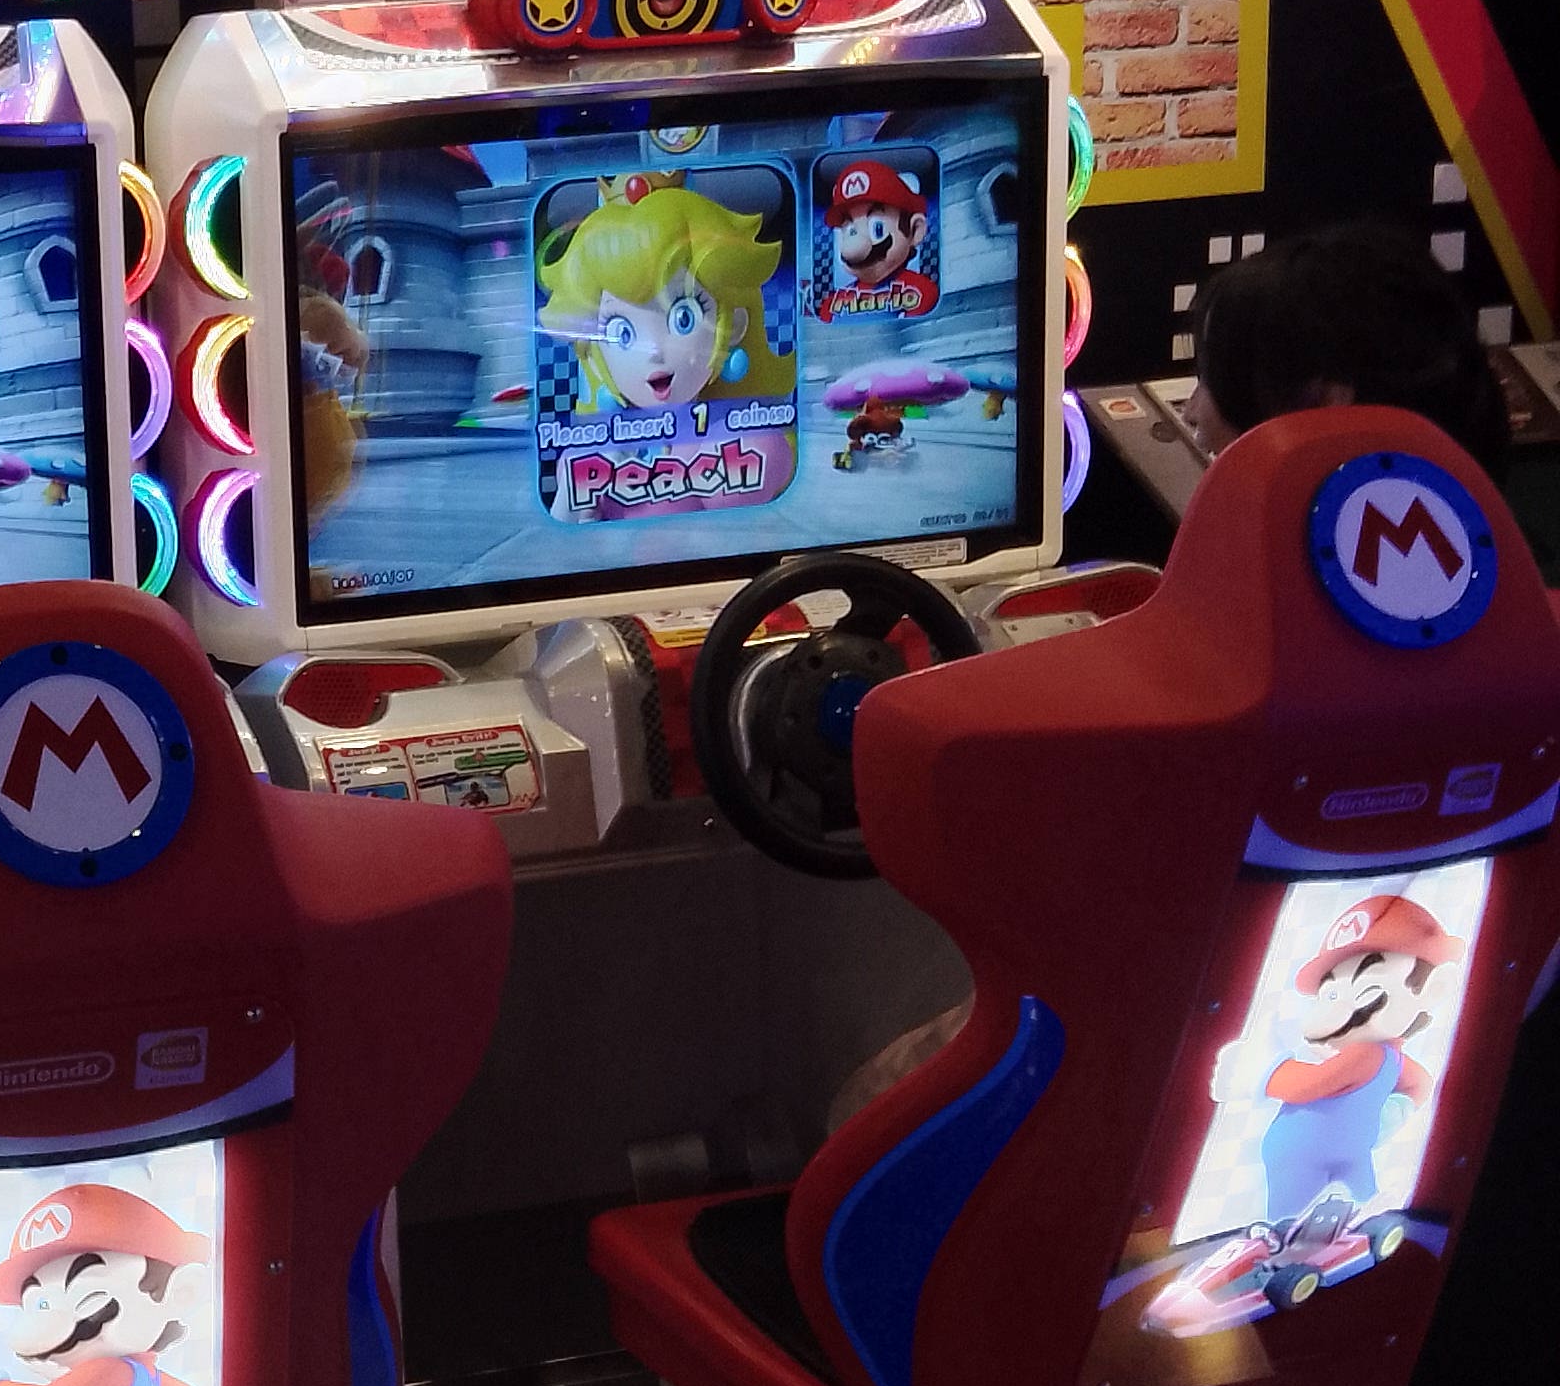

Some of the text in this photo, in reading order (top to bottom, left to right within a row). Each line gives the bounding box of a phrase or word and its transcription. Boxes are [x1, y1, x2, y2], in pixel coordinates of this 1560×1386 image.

[832, 283, 922, 315] Mario
[538, 402, 795, 449] Please insert 1 coin(s)
[568, 438, 765, 510] Peach
[1352, 496, 1465, 586] M
[0, 695, 153, 812] M
